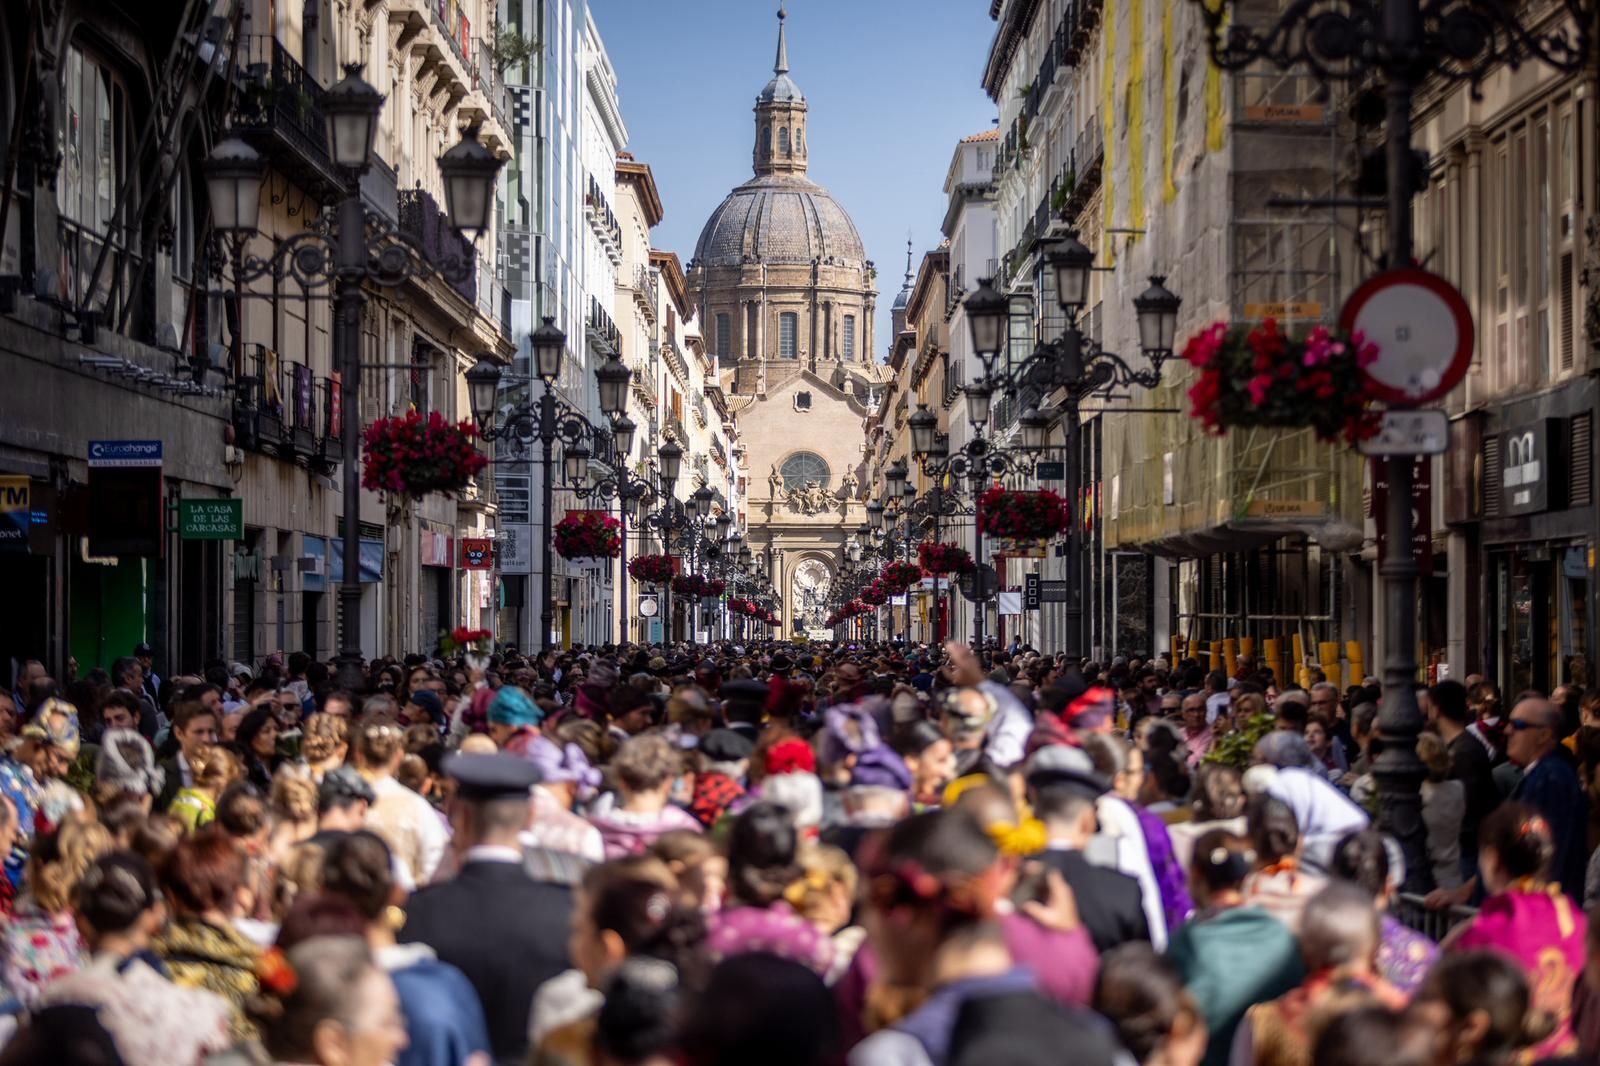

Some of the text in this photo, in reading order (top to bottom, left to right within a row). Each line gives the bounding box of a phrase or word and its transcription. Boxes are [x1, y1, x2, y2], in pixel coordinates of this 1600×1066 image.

[104, 443, 157, 454] Eurochange
[190, 505, 232, 513] LA CASA
[193, 514, 230, 523] DE LAS
[185, 524, 237, 533] CARCASAS
